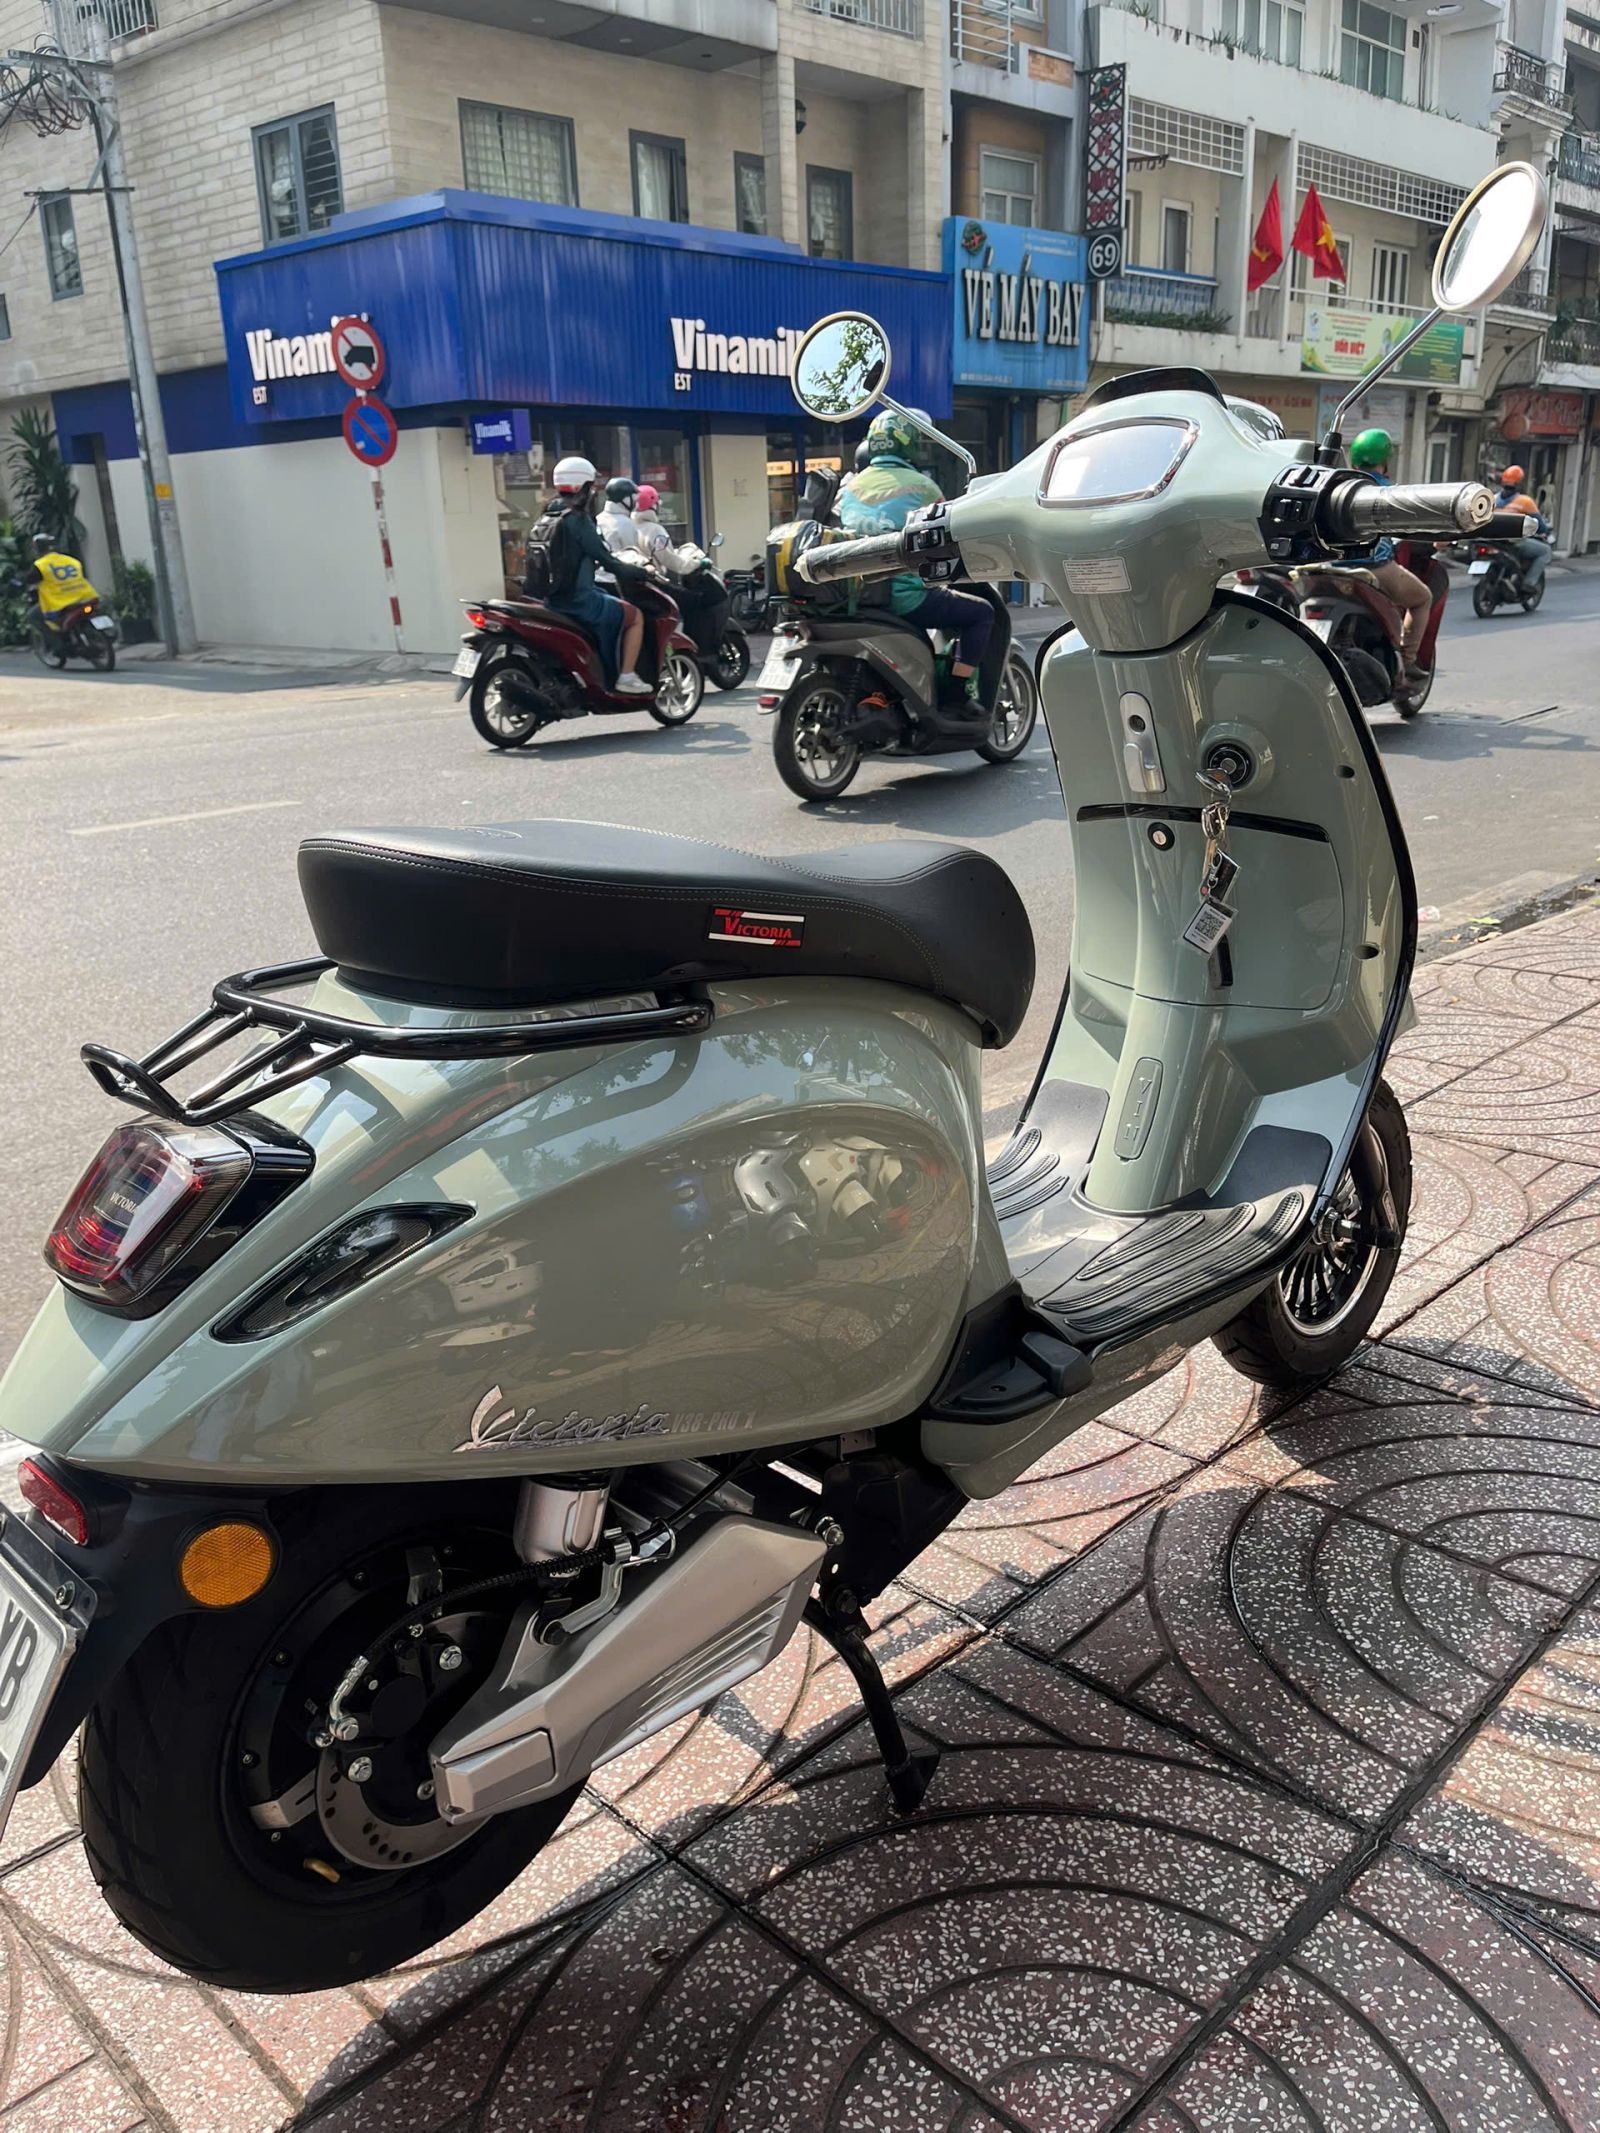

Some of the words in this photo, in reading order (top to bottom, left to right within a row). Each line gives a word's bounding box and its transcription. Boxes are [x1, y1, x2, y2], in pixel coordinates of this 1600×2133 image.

[1092, 243, 1116, 269] 69
[964, 245, 994, 339] VÉ
[998, 253, 1043, 342] MÁY
[1047, 280, 1086, 346] BAY
[246, 316, 356, 382] Vinam
[671, 317, 806, 377] Vinamil
[674, 373, 691, 391] EST
[869, 439, 894, 451] Grab
[49, 563, 79, 580] be
[452, 1385, 670, 1453] Victoria
